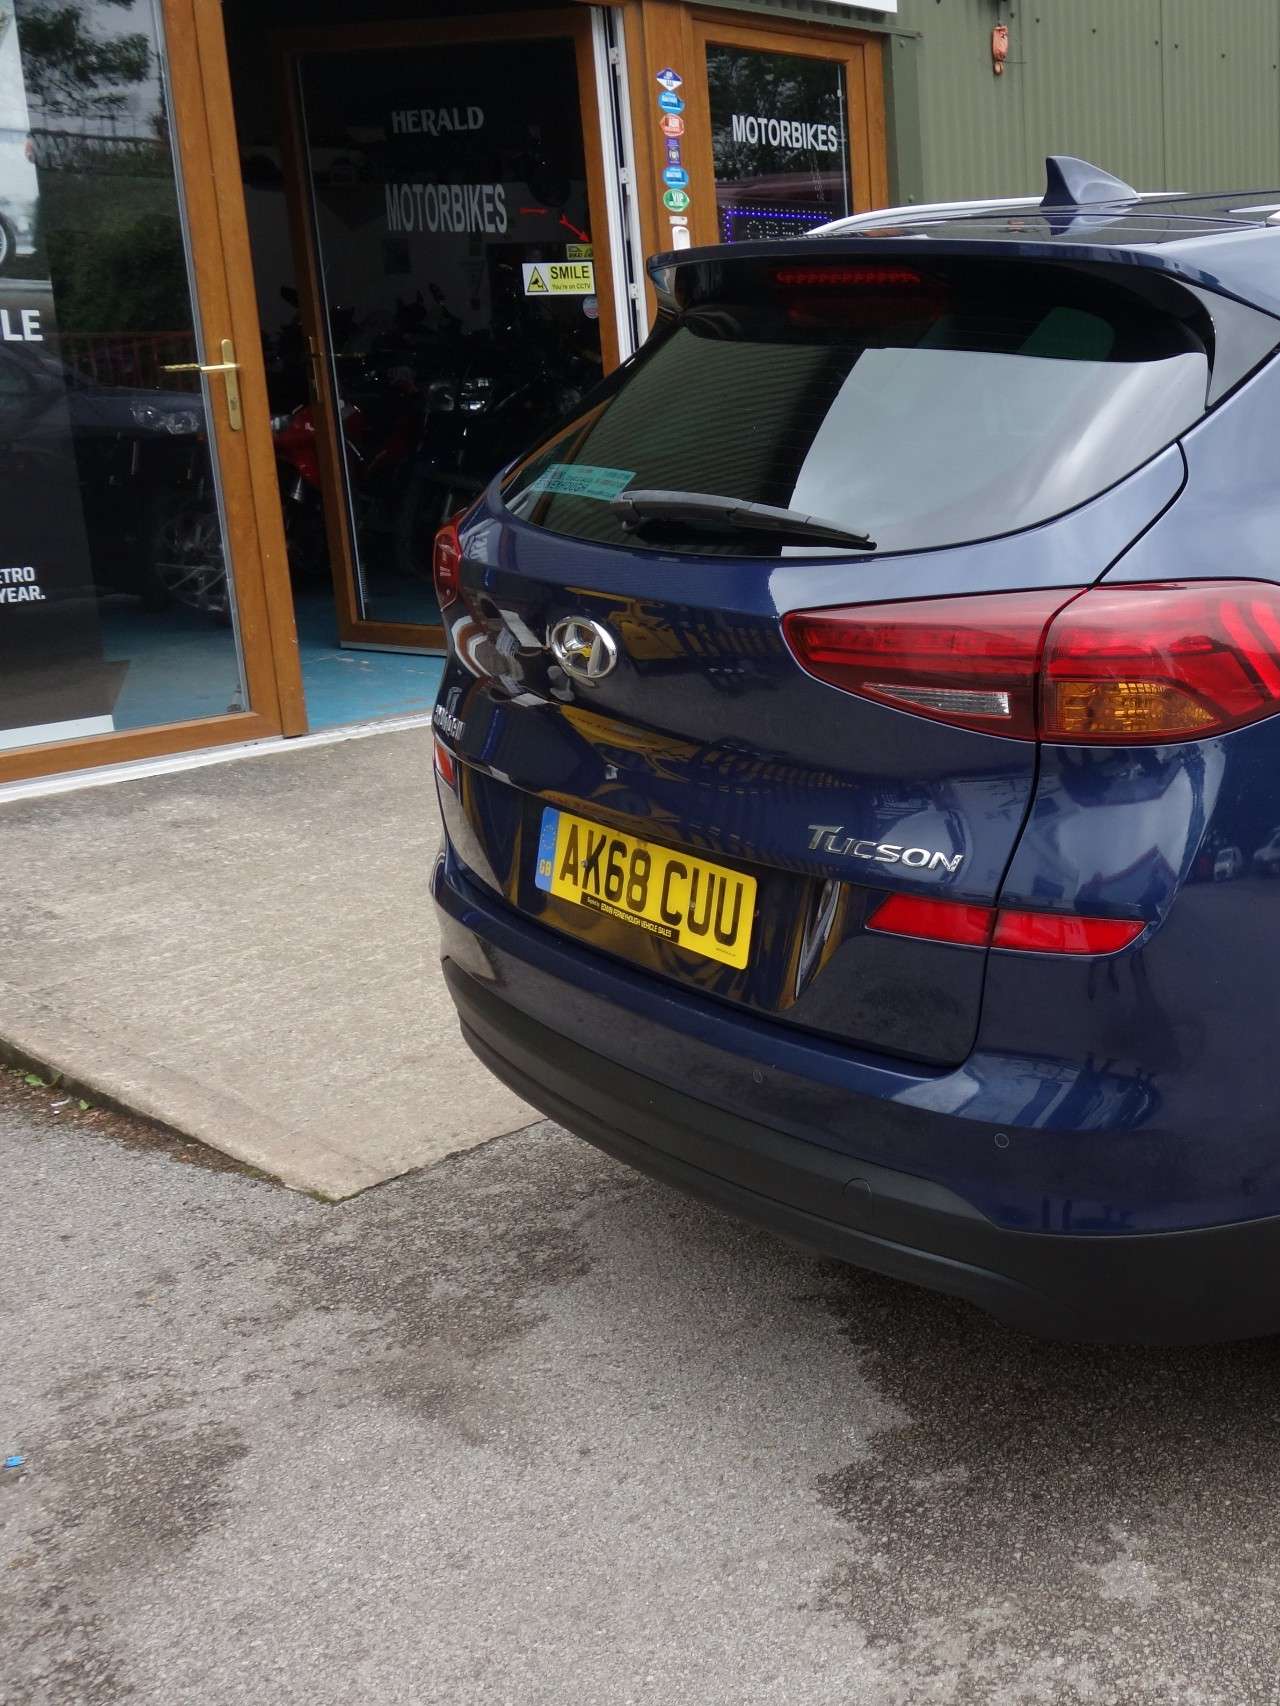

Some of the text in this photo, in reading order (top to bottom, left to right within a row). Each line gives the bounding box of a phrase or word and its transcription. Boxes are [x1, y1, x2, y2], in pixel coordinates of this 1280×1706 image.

[391, 106, 485, 136] HERALD
[732, 114, 838, 152] MOTORBIKES
[384, 183, 508, 233] MOTORBIKES
[550, 265, 590, 279] SMILE
[0, 566, 36, 584] TRO
[807, 824, 964, 873] TUCSON
[540, 858, 552, 877] GB
[559, 823, 743, 947] AK68 CUU
